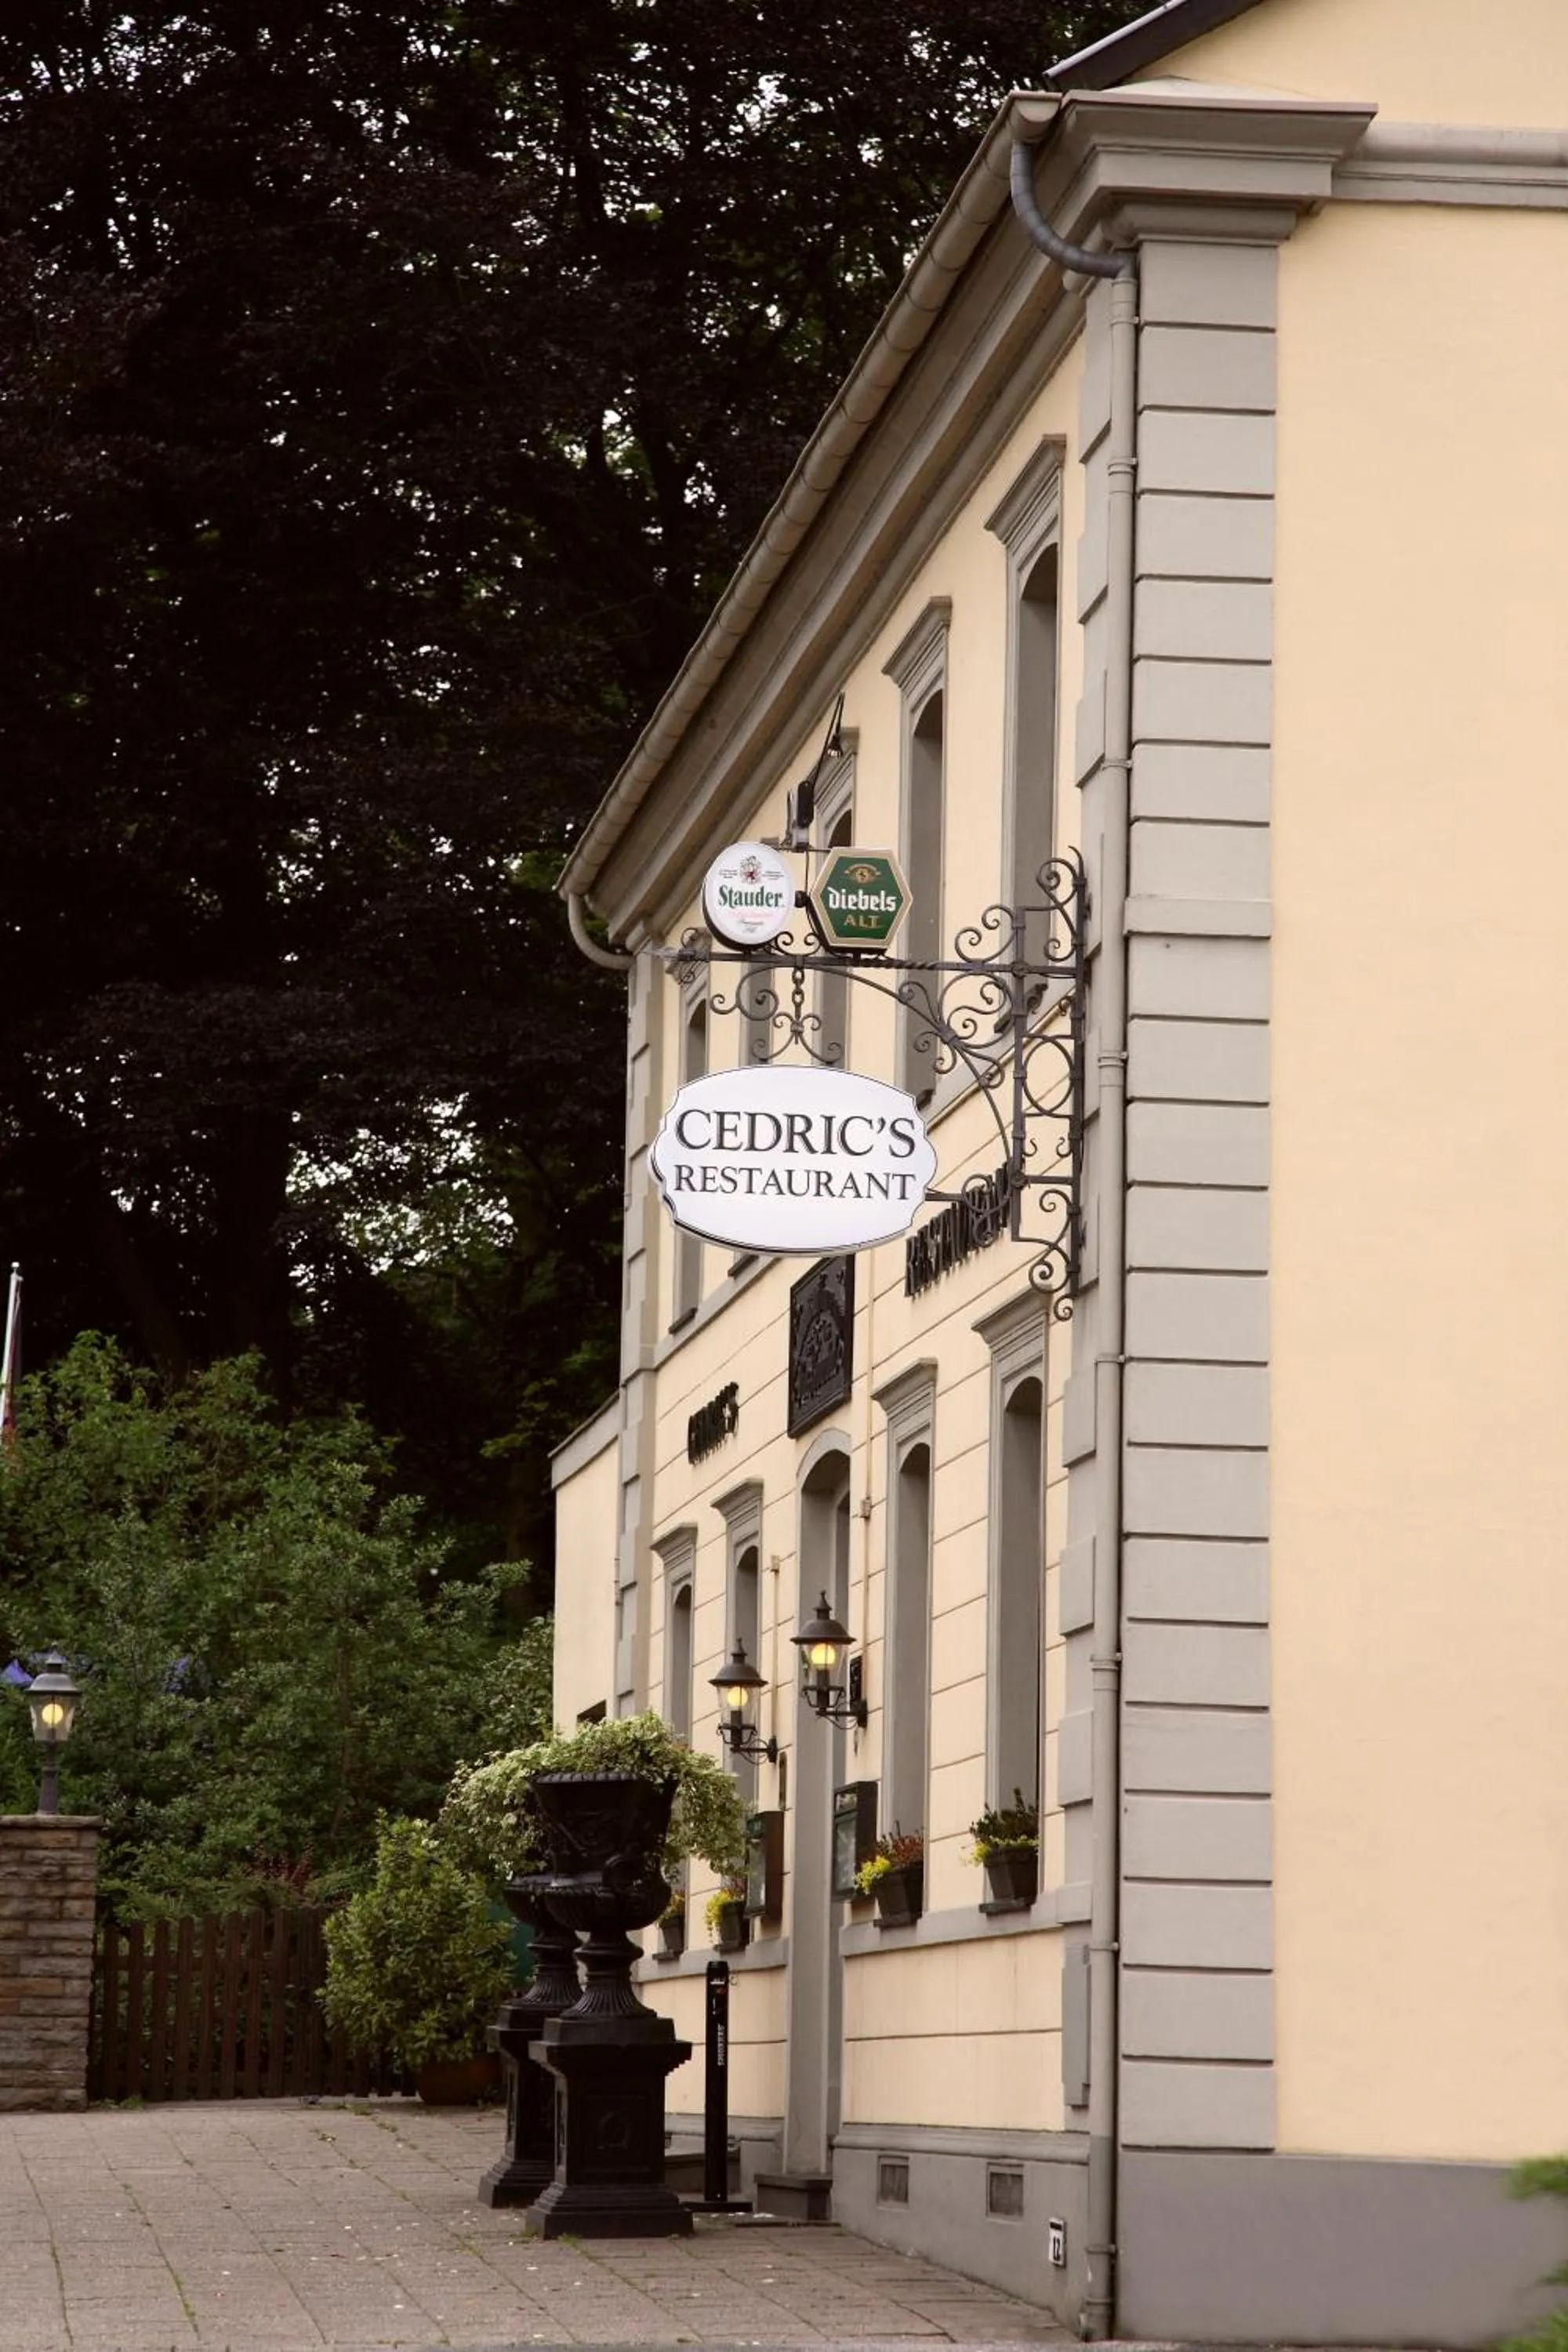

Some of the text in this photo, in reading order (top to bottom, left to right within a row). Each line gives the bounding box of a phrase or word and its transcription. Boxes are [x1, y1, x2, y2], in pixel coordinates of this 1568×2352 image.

[718, 884, 782, 909] Stauder
[844, 914, 879, 928] ALT
[676, 1109, 916, 1158] CEDRIC'S
[673, 1164, 916, 1200] RESTAURANT
